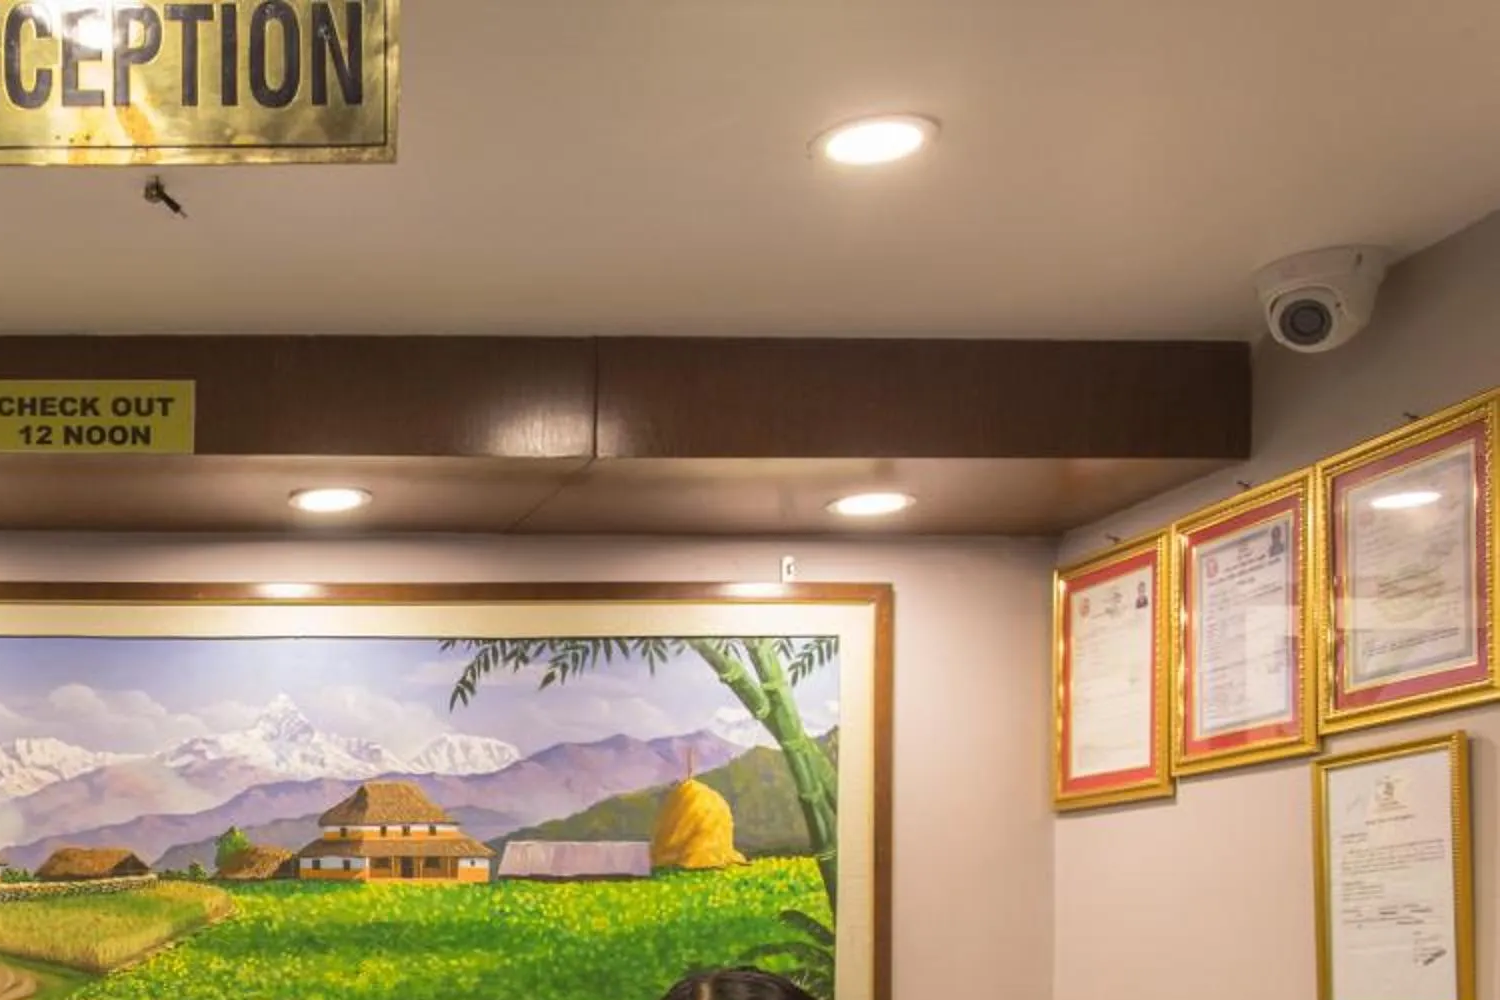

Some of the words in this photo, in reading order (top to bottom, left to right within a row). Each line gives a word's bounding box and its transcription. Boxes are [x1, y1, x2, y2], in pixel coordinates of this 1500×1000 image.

[111, 397, 175, 417] OUT
[18, 426, 53, 445] 12
[63, 426, 151, 445] NOON
